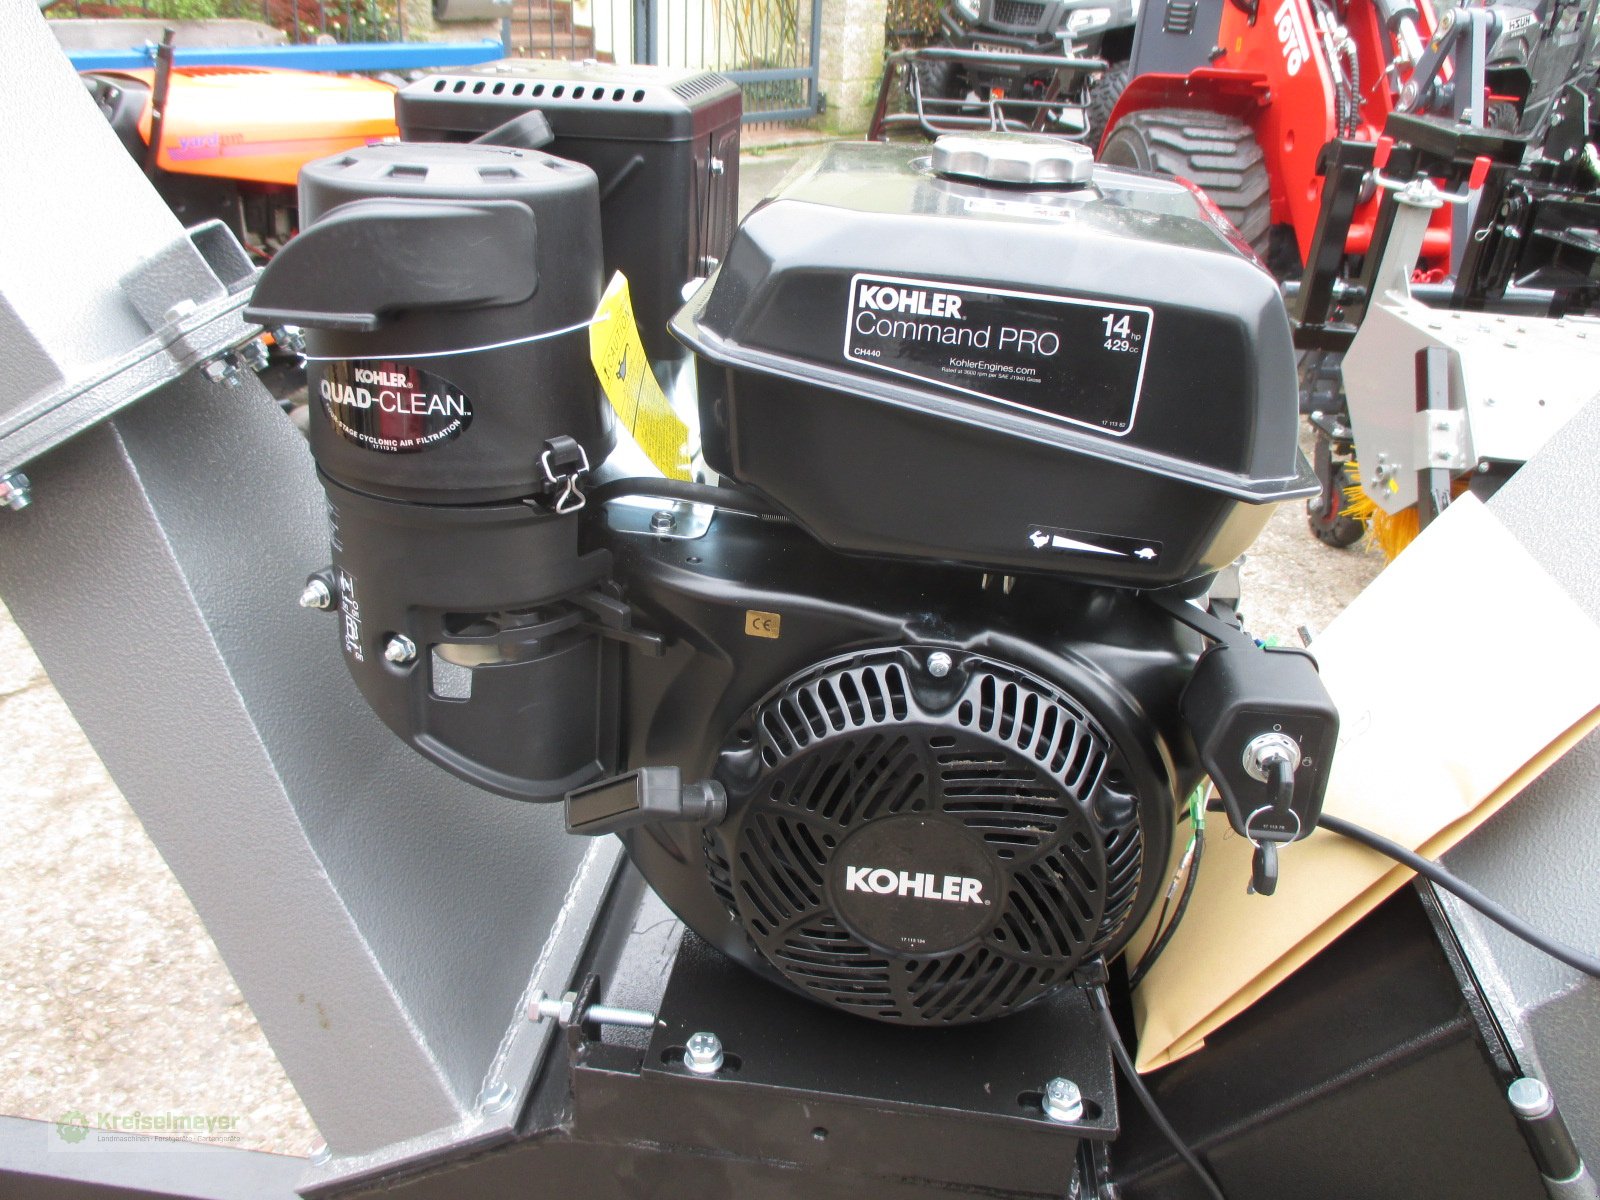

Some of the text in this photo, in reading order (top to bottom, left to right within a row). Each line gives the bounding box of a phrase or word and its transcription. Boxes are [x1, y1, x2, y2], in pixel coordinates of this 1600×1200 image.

[858, 284, 963, 319] KOHLER
[607, 308, 631, 365] CAUTION
[855, 311, 1060, 357] Command PRO
[1102, 313, 1131, 338] 14
[853, 346, 881, 358] CH440
[1103, 338, 1129, 352] 429
[354, 368, 407, 388] KOHLER
[949, 357, 1036, 376] KohlerEngines.com
[358, 433, 398, 447] CYCLONIC
[400, 438, 414, 447] AIR
[416, 418, 461, 445] FILTRATION
[845, 865, 984, 904] KOHLER
